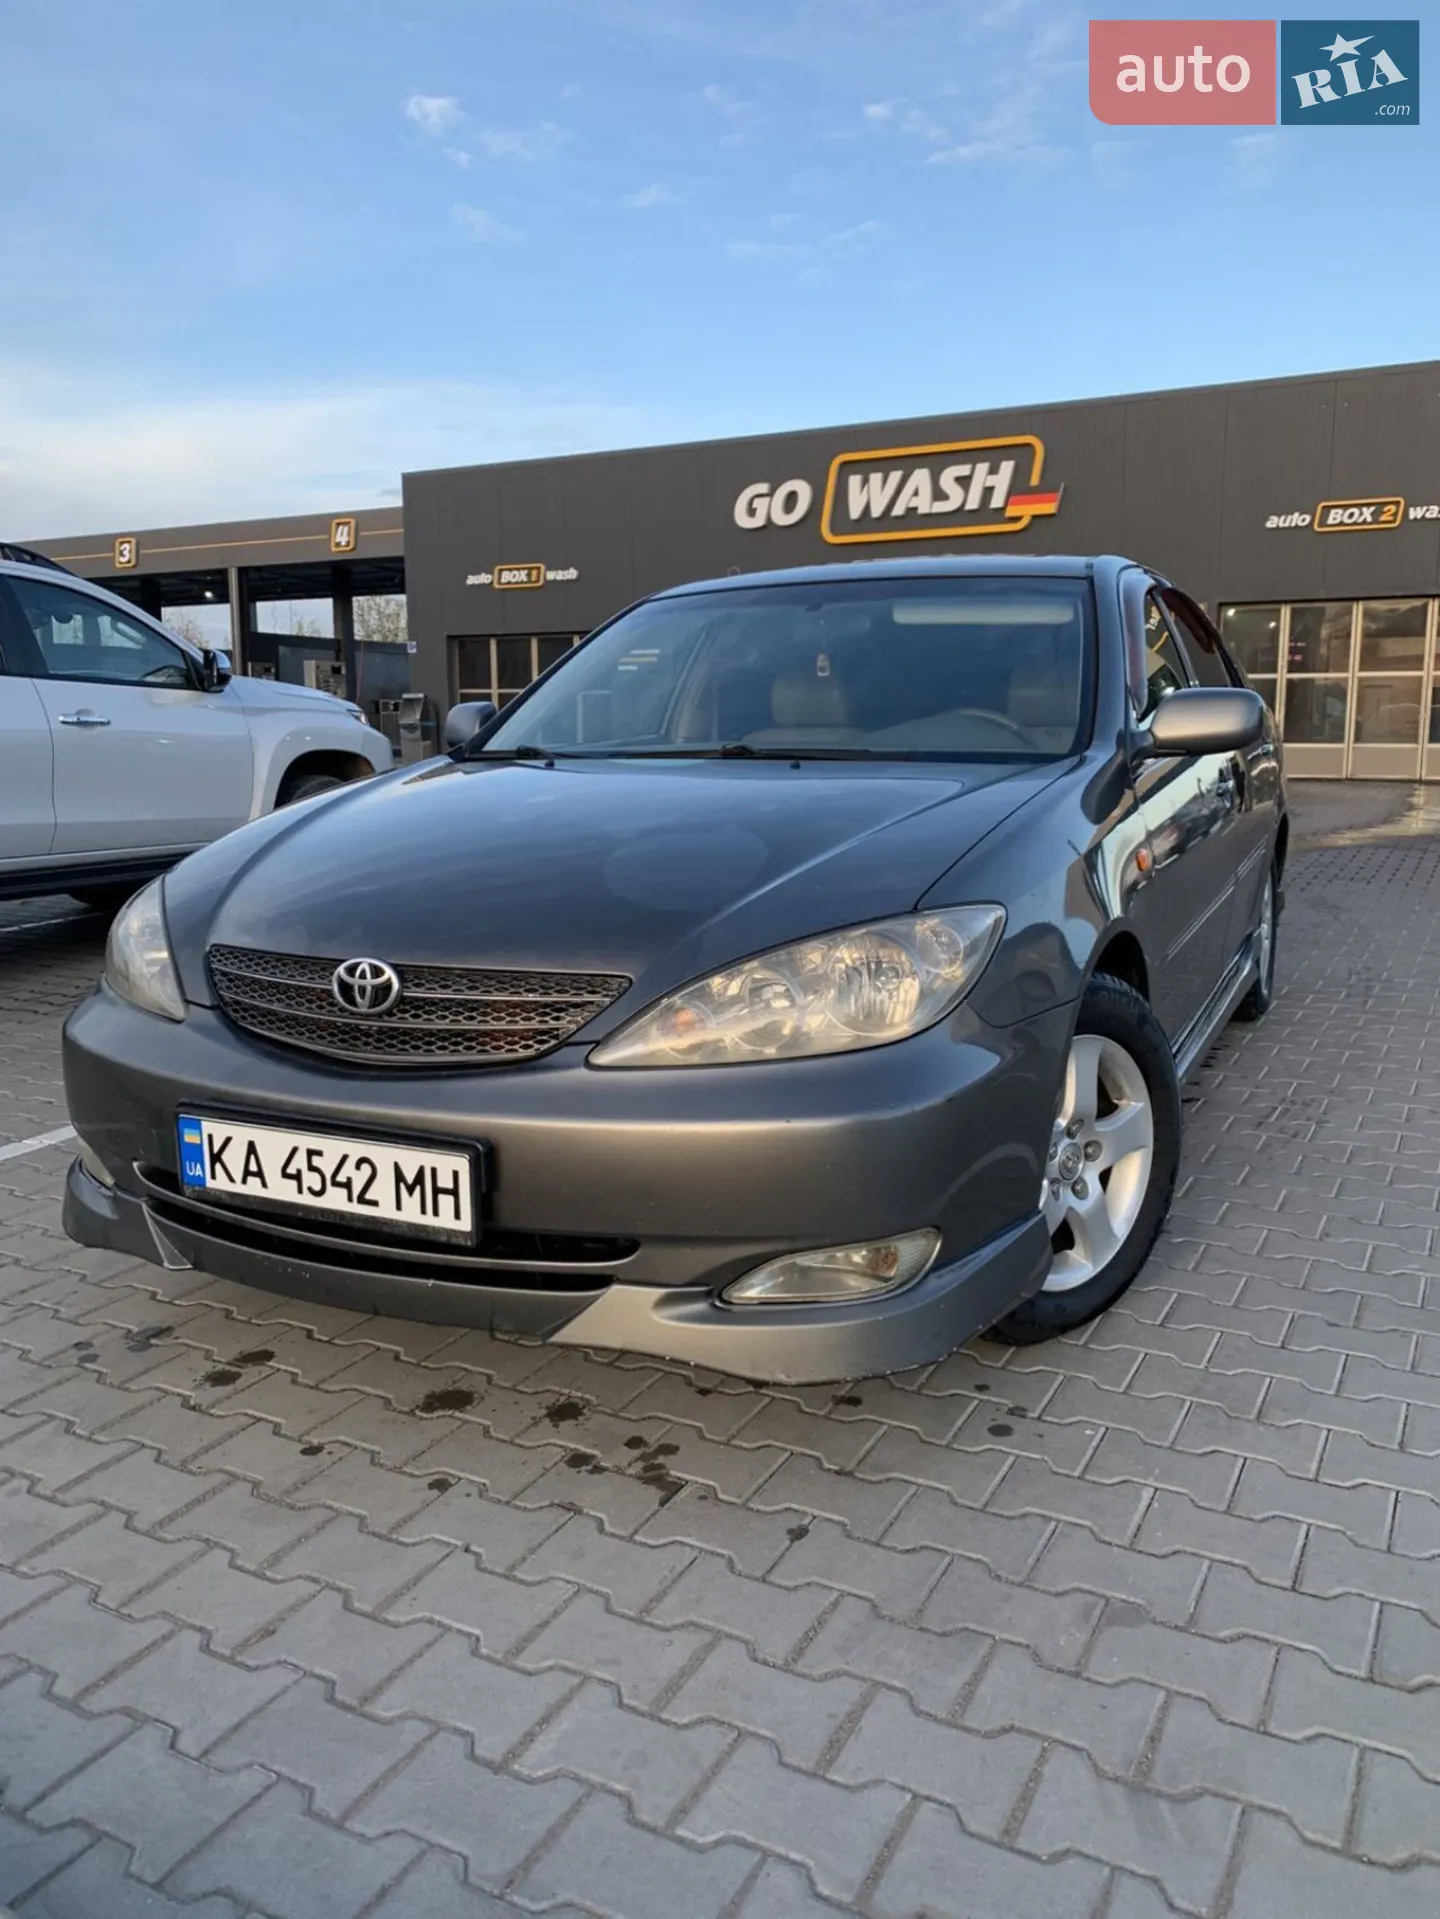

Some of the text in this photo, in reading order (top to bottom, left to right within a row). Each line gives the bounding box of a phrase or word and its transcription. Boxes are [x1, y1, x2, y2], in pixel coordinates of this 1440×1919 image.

[733, 460, 1016, 530] GO WASH
[1265, 504, 1440, 529] auto BOX 2 wa
[335, 524, 349, 546] 4
[118, 542, 131, 563] 3
[466, 567, 579, 585] auto BOX 1 wash
[186, 1160, 204, 1178] UA
[207, 1133, 462, 1221] KA 4542 MH
